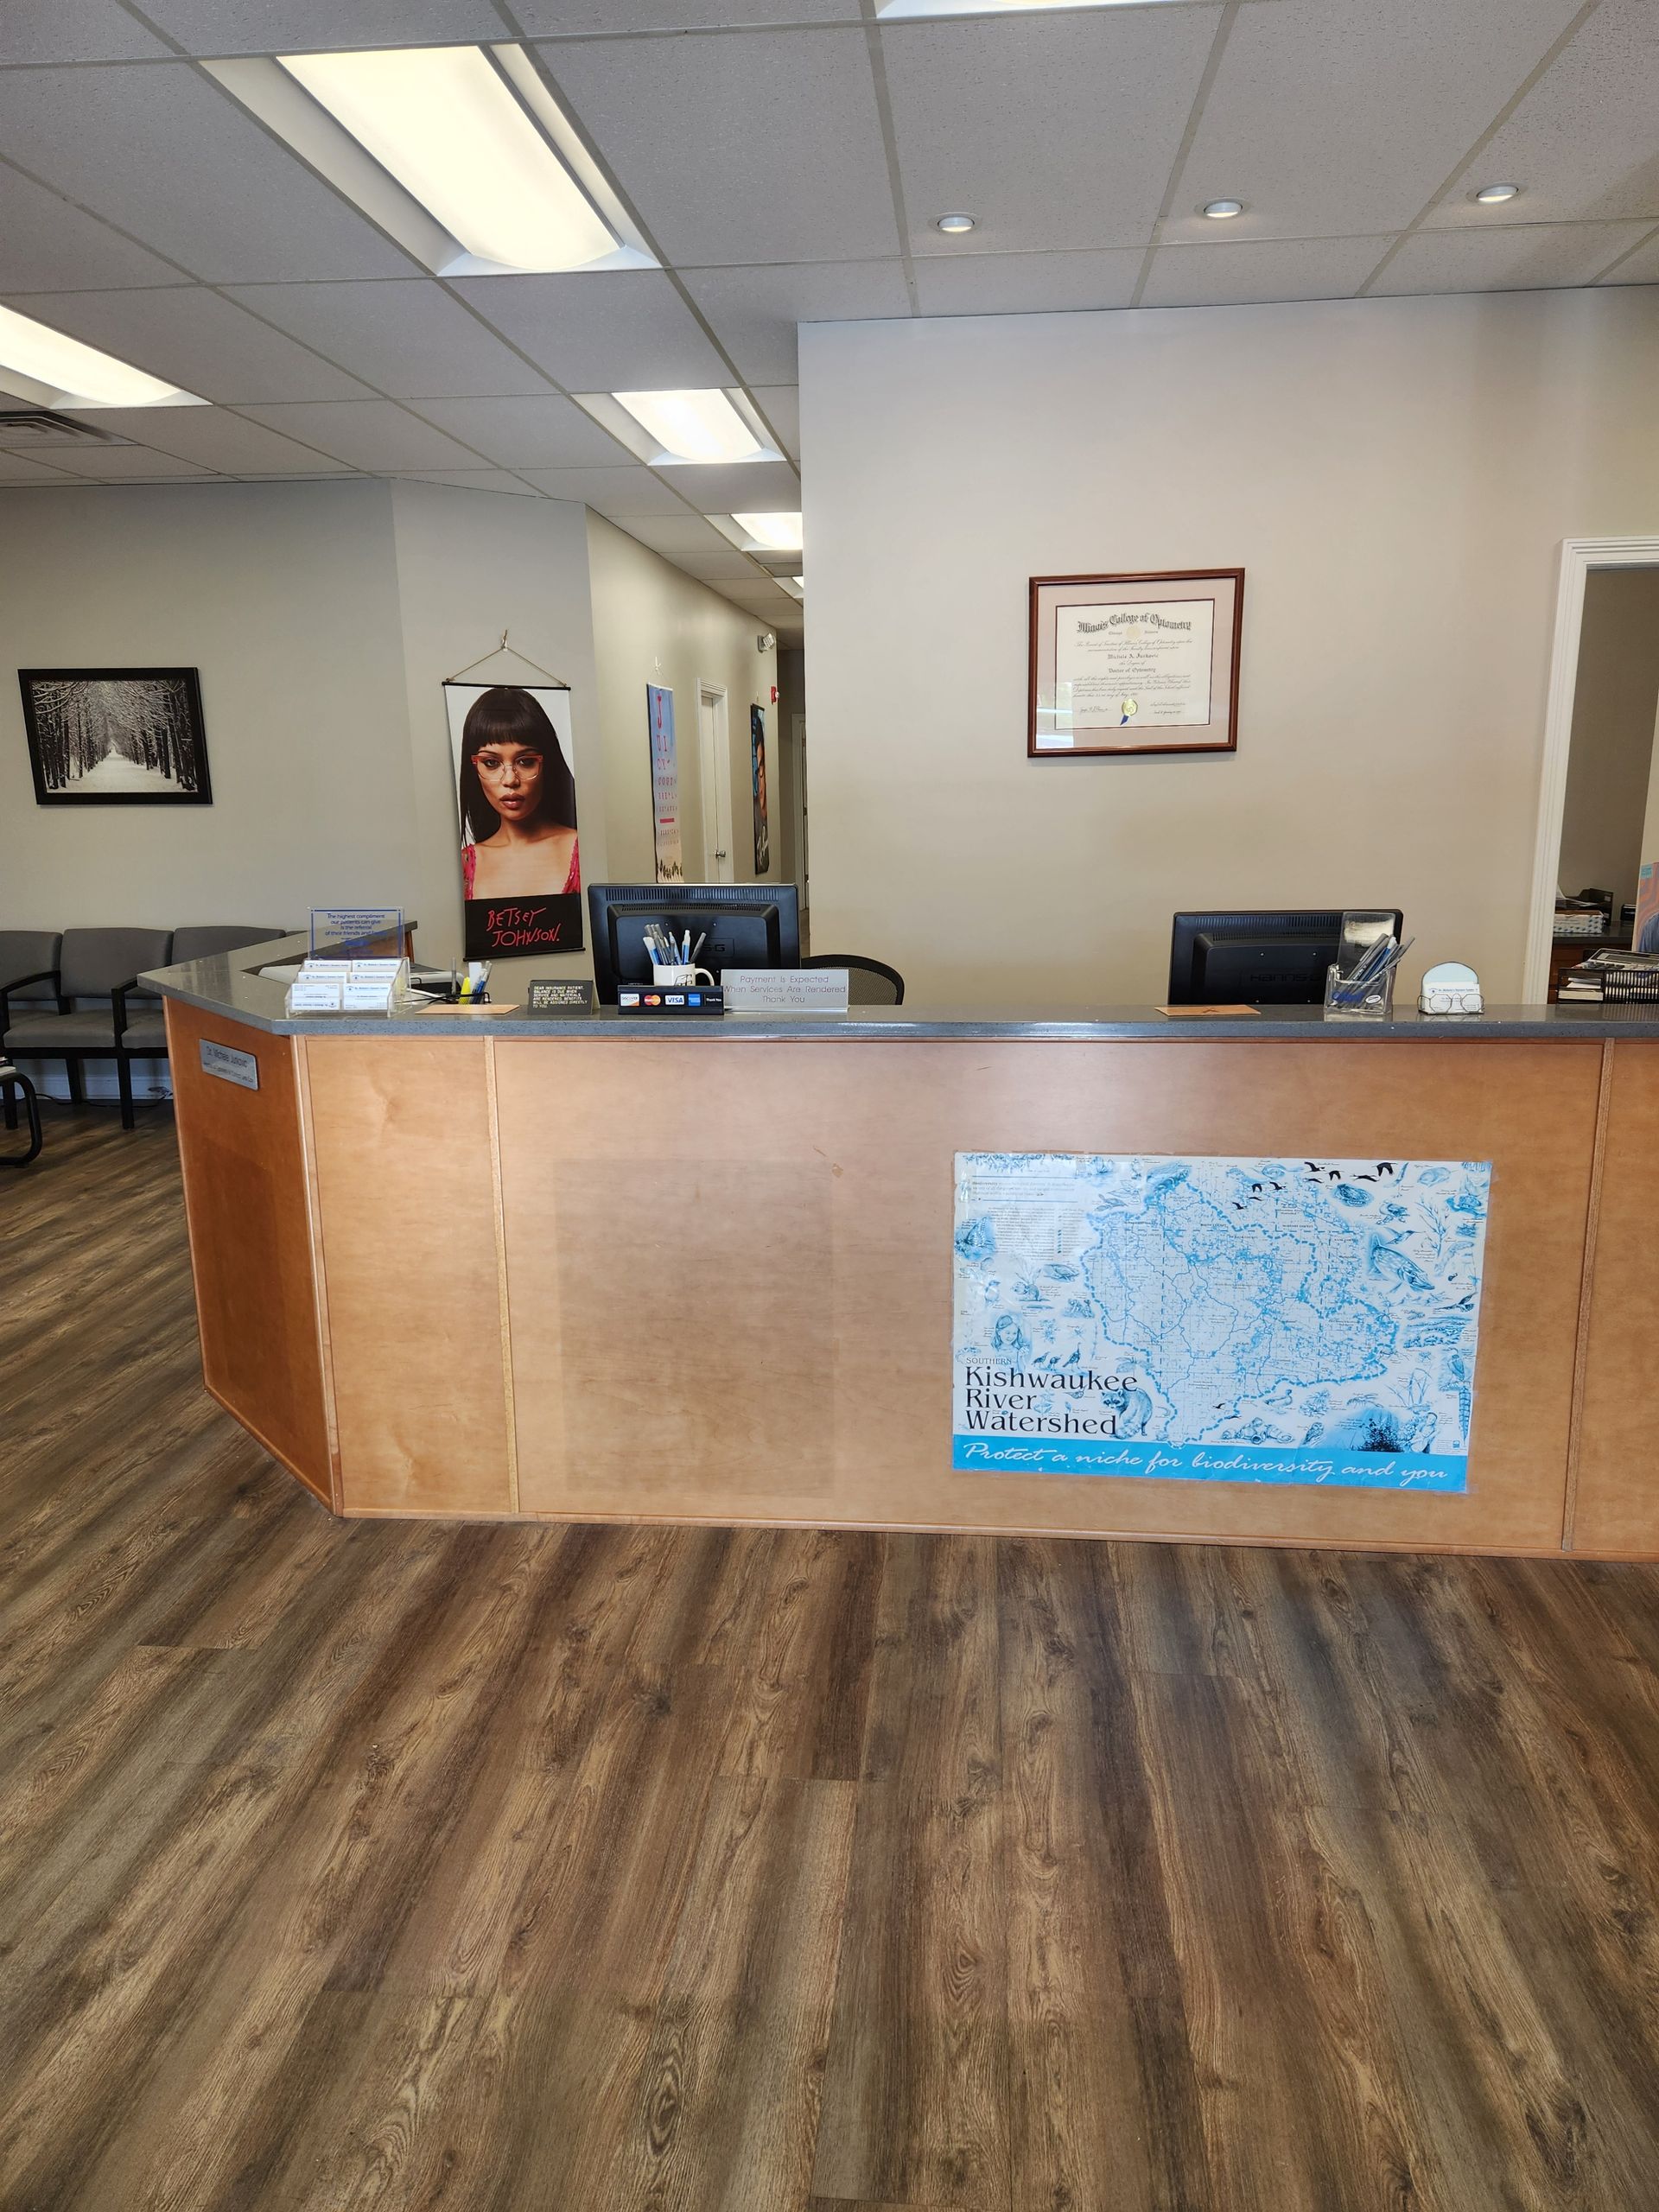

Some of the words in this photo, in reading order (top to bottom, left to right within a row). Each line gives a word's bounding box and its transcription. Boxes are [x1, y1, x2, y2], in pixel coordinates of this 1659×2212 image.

[1109, 613, 1139, 626] College
[1140, 613, 1150, 623] of
[1149, 613, 1192, 631] Optometry
[486, 907, 547, 931] BETSEY
[740, 975, 776, 984] Payment
[780, 975, 786, 983] Is
[790, 975, 830, 984] Expected
[965, 1365, 1138, 1392] Kishwaukee
[965, 1388, 1038, 1410] River
[965, 1410, 1116, 1435] Watershed
[963, 1442, 1057, 1461] Protect
[1052, 1452, 1068, 1462] a
[1075, 1450, 1144, 1465] niche
[1144, 1451, 1182, 1474] for
[1192, 1451, 1336, 1483] biodiversity
[1341, 1460, 1396, 1477] and
[1400, 1468, 1448, 1487] you
